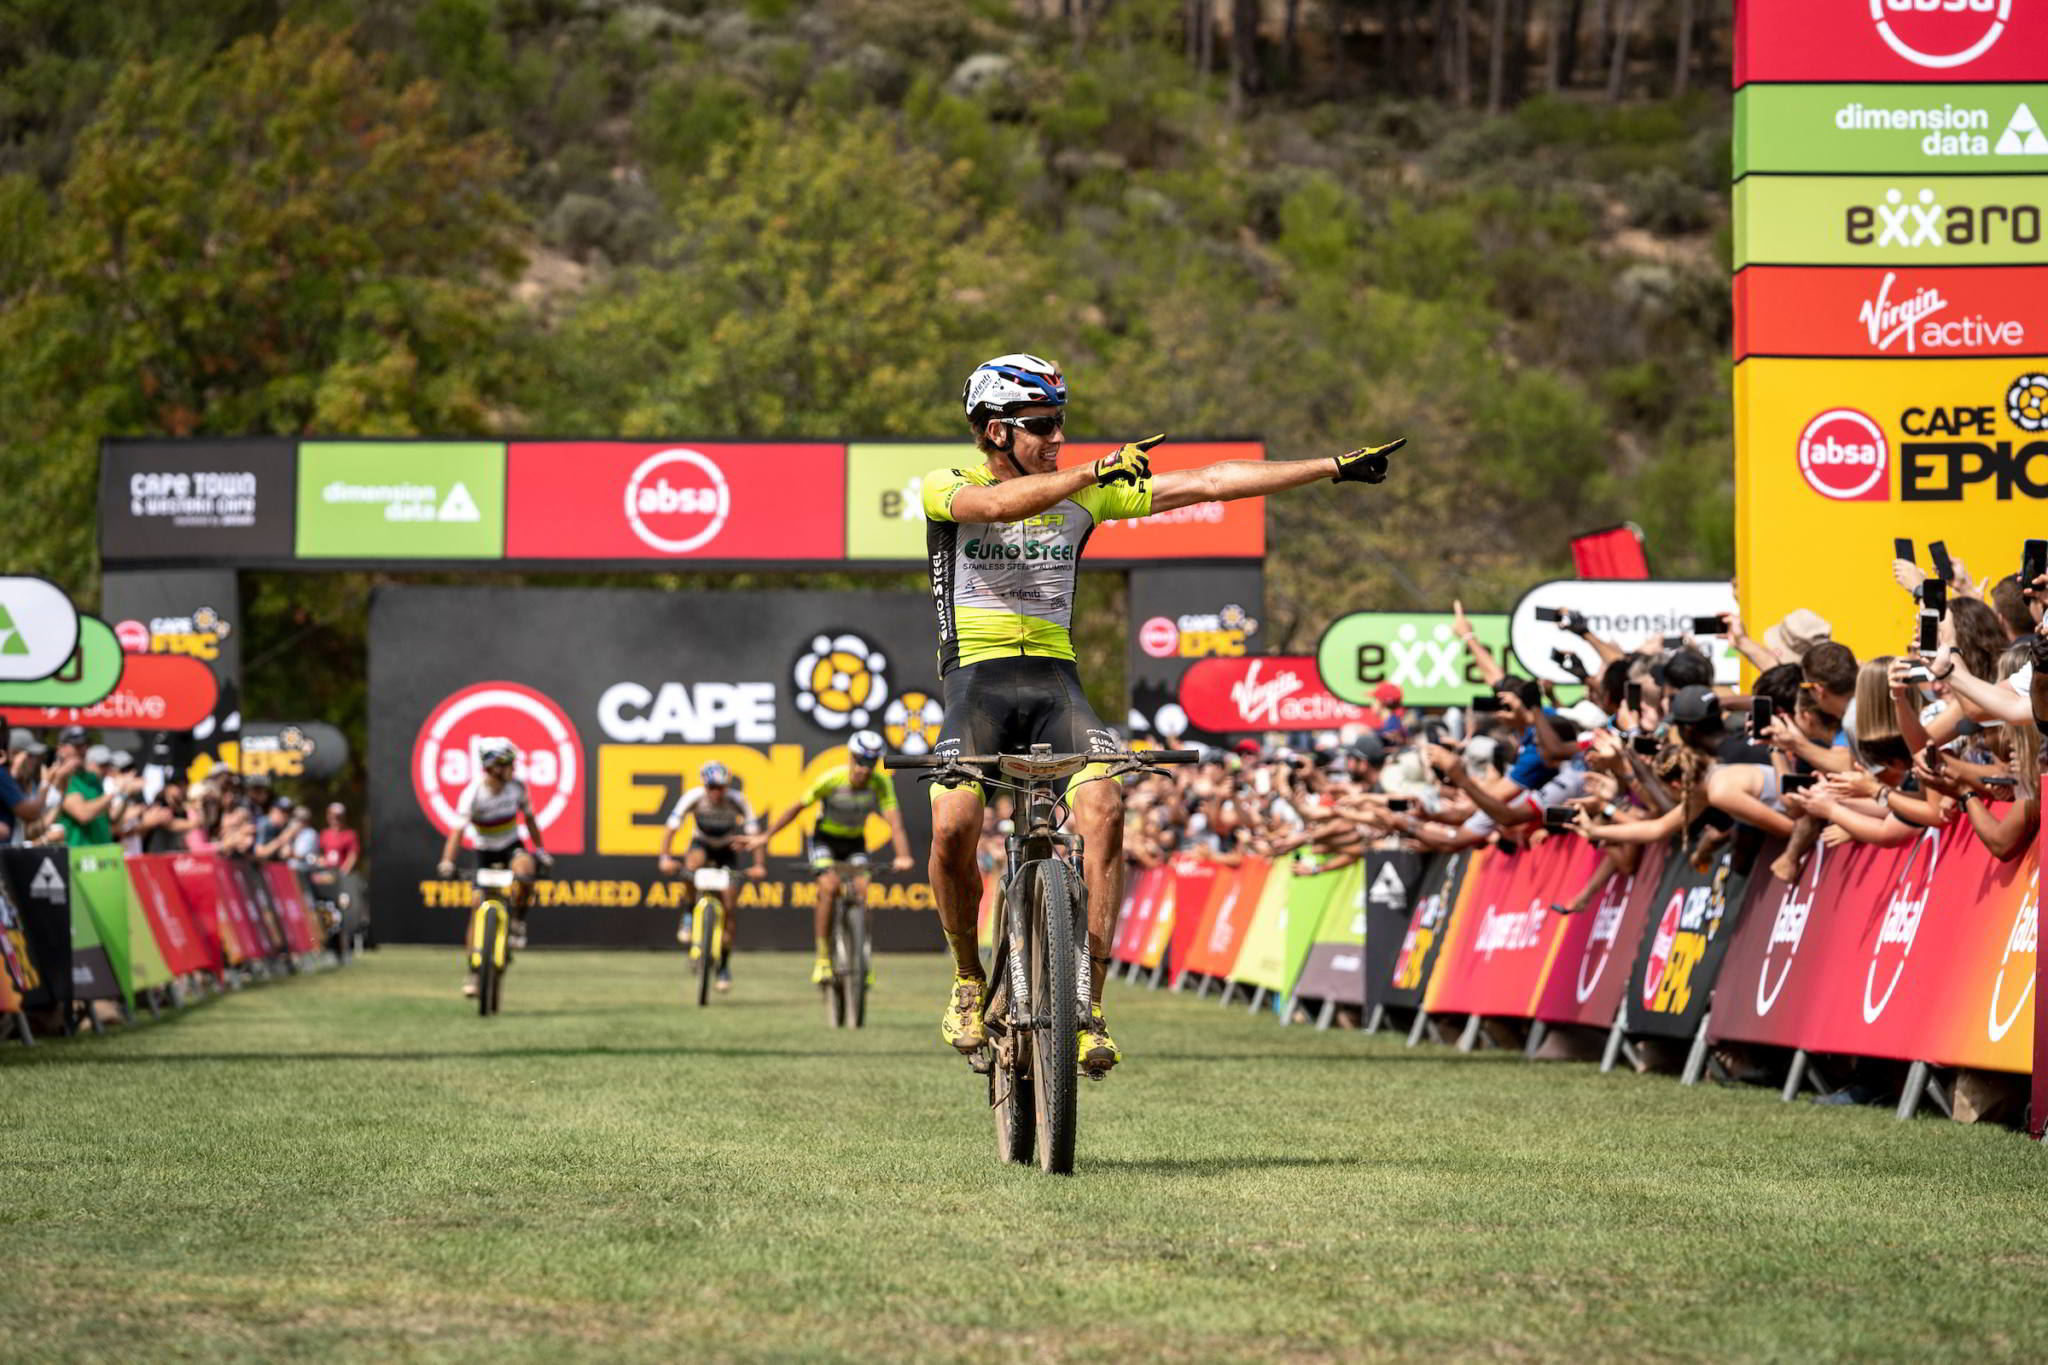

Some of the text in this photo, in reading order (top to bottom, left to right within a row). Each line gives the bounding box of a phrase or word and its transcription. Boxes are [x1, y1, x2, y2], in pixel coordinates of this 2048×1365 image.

[1835, 103, 1989, 130] dimension
[1921, 131, 1989, 156] data
[1846, 188, 2041, 247] exxaro
[1859, 272, 1948, 353] Virgin
[1921, 314, 2025, 347] active
[985, 402, 1004, 412] uvex
[1900, 407, 1996, 436] CAPE
[1810, 436, 1877, 464] absa
[1900, 441, 2048, 501] EPIC
[637, 478, 718, 514] absa
[962, 563, 1005, 571] STAINLESS
[1007, 563, 1029, 571] STEEL
[964, 539, 1074, 561] EURO STEEL
[932, 551, 948, 641] EURO STEEL
[1587, 608, 1694, 632] mensio
[598, 681, 776, 743] CAPE
[440, 734, 558, 787] aa
[1882, 881, 1921, 943] absa
[2012, 898, 2038, 952] abs
[1010, 948, 1030, 1002] ROCKSHO
